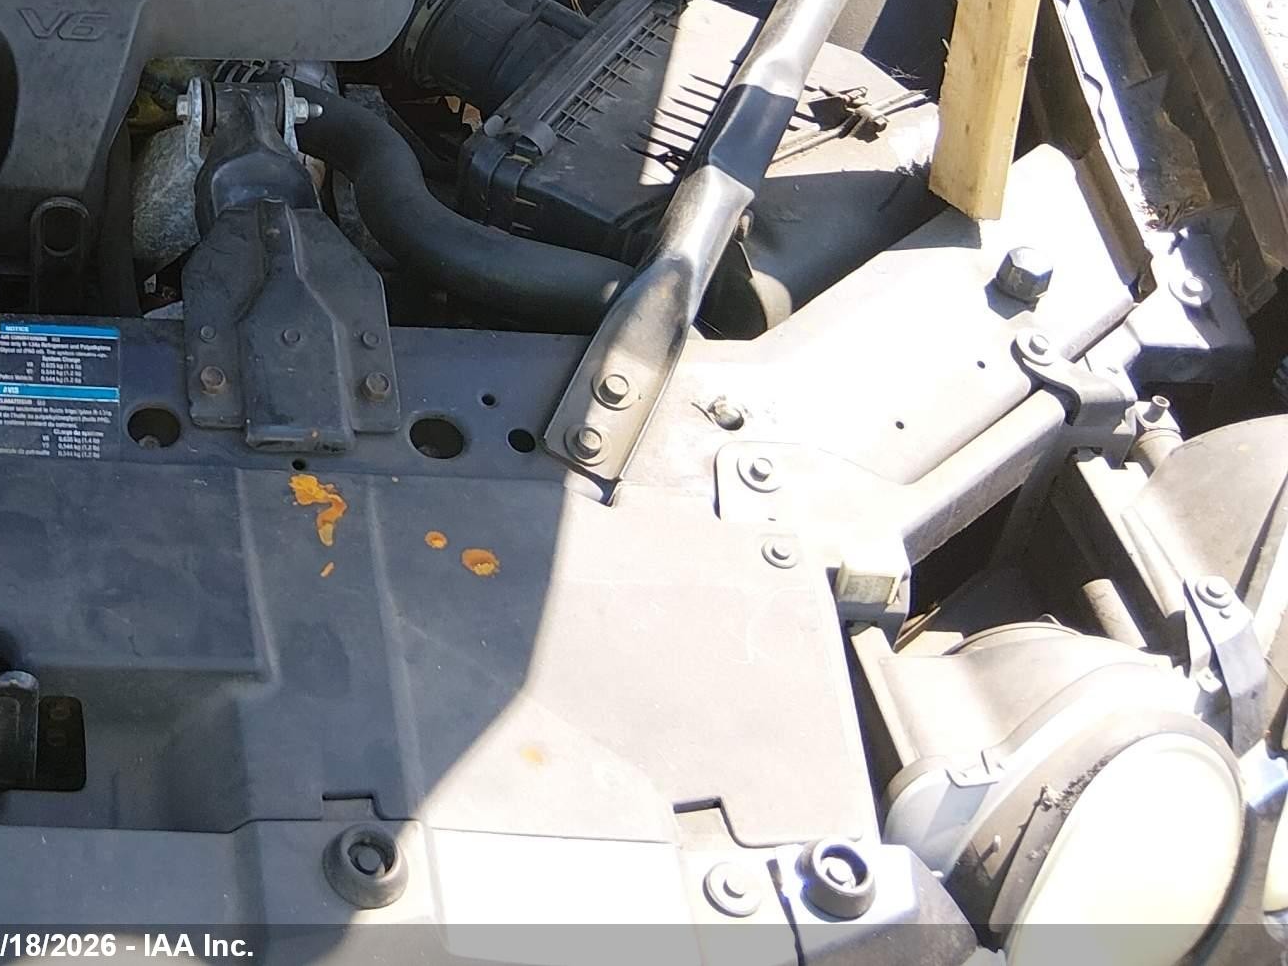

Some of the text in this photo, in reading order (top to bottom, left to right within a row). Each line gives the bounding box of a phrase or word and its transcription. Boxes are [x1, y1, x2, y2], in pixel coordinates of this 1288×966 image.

[17, 8, 112, 42] V6
[5, 325, 29, 333] NOTICE
[3, 386, 19, 395] AVIS
